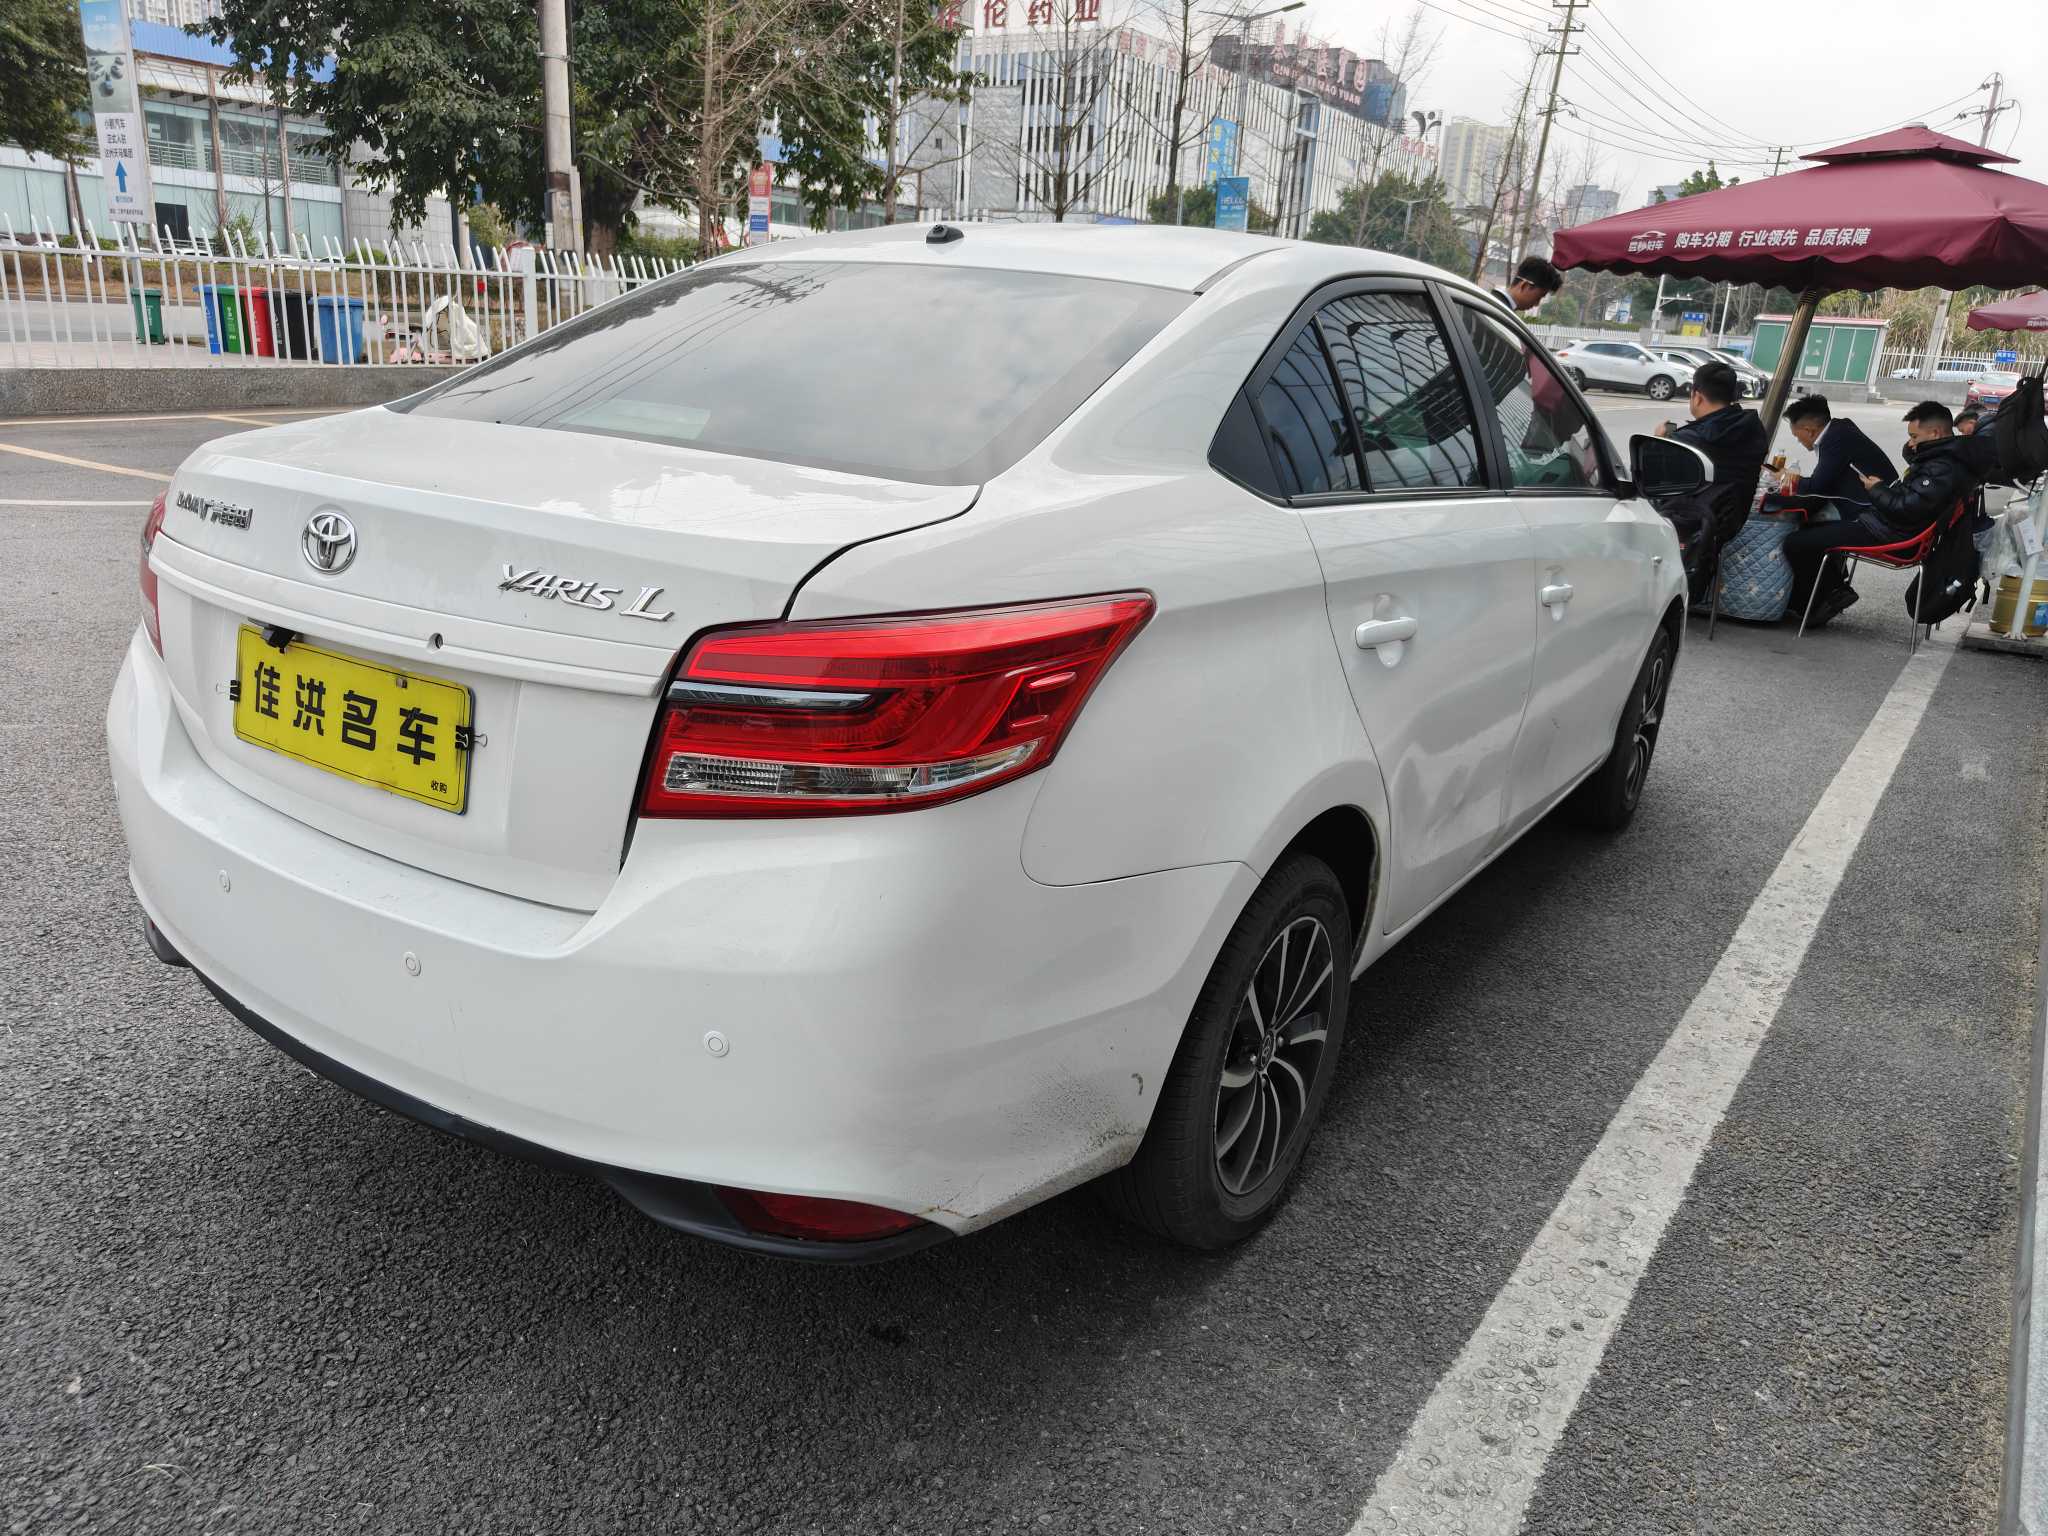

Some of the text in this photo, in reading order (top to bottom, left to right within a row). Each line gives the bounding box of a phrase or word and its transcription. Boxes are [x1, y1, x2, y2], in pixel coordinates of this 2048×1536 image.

[1674, 230, 1733, 249] 购车分期
[1738, 229, 1799, 248] 行业领先
[1804, 227, 1872, 247] 品质保障
[619, 586, 676, 622] L
[254, 660, 439, 766] 佳洪名车
[430, 779, 448, 794] 收购
